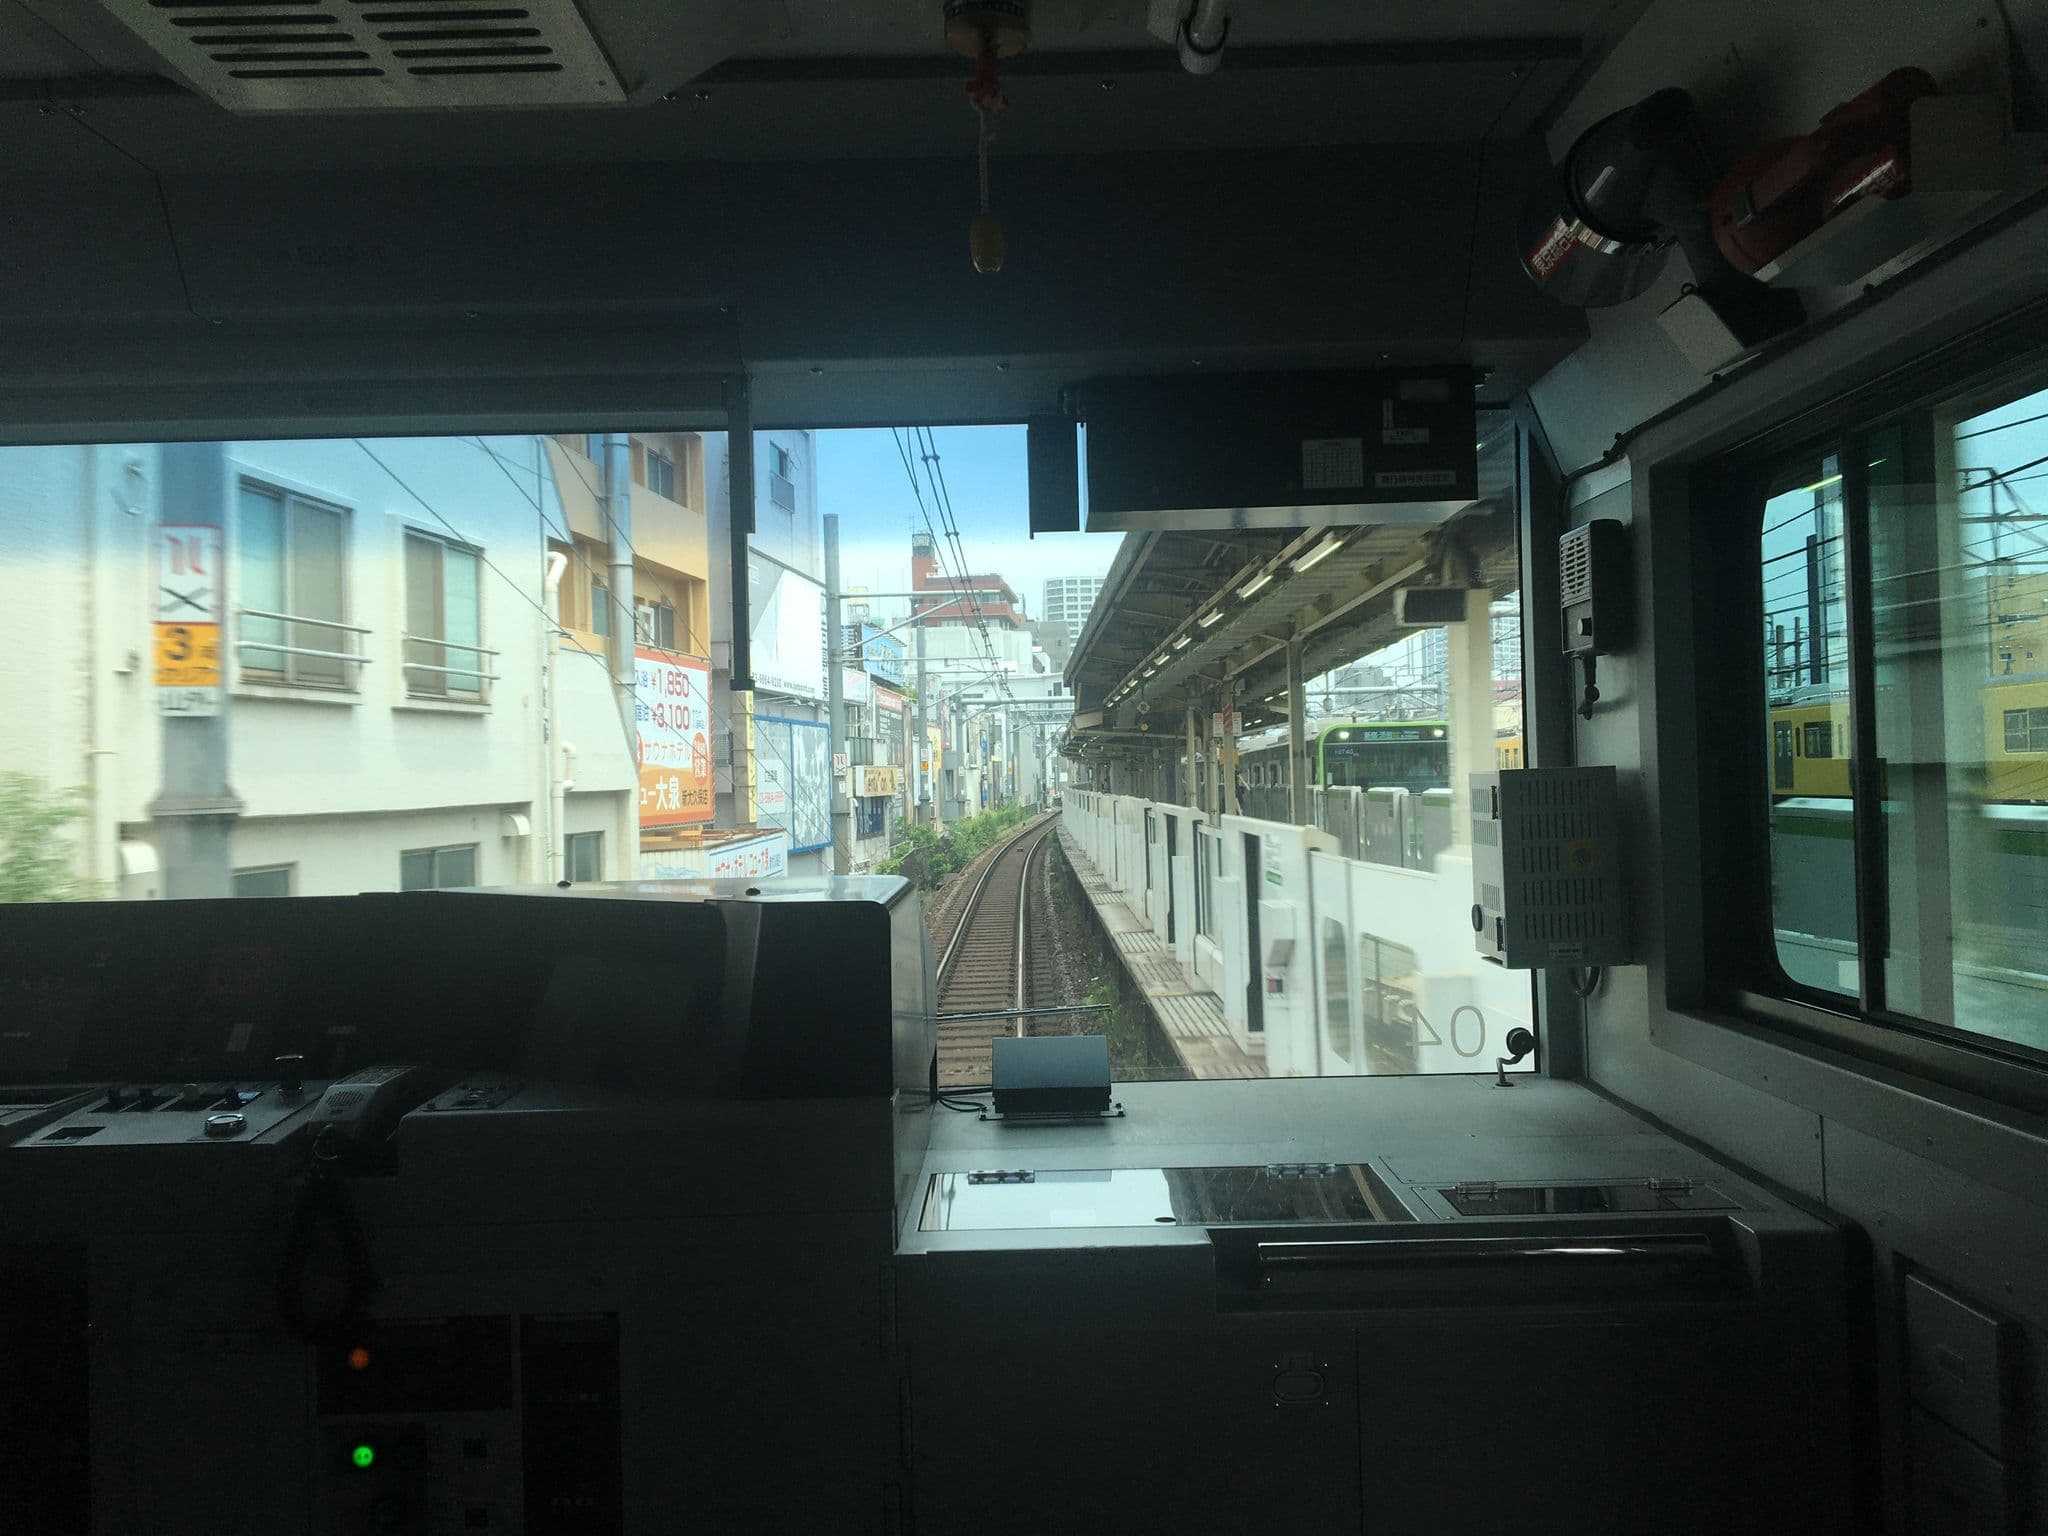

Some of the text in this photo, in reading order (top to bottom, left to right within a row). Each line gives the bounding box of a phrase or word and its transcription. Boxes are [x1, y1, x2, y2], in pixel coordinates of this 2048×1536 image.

[651, 668, 690, 698] ¥1,850
[651, 702, 690, 732] ¥3,100
[645, 742, 691, 761] サウナホテル
